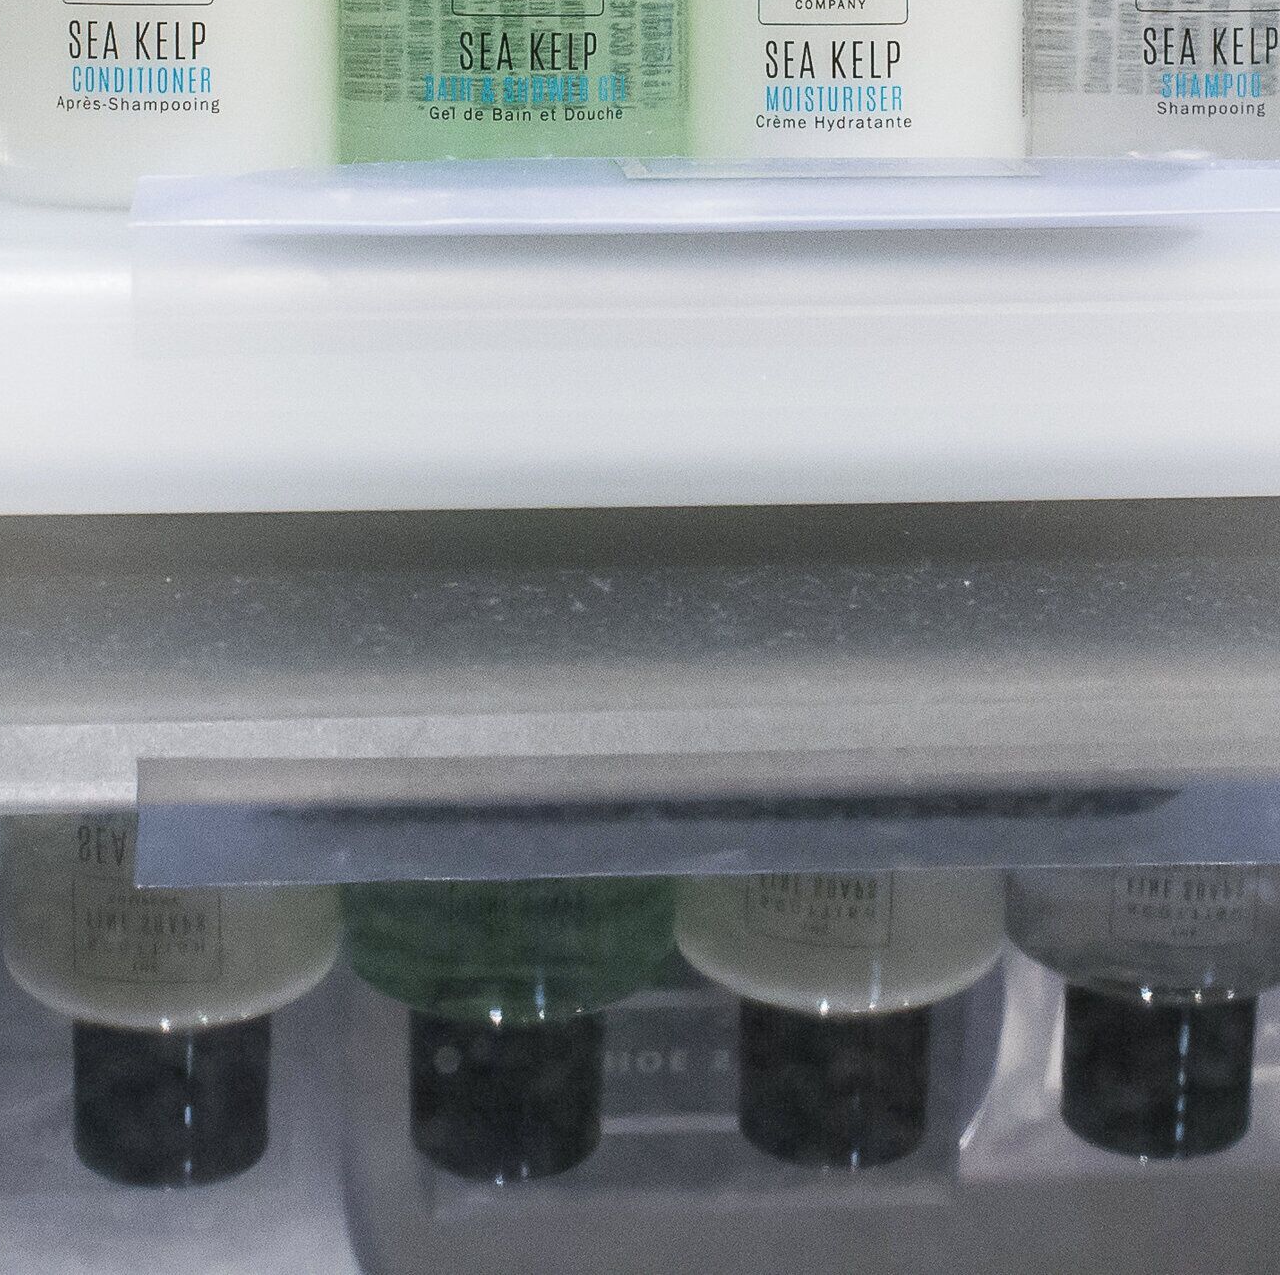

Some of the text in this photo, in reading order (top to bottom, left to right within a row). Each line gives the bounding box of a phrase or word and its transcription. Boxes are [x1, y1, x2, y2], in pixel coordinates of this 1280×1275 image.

[795, 0, 867, 11] COMPANY
[68, 19, 207, 61] SEA KELP
[459, 31, 597, 72] SEA KELP
[1143, 26, 1278, 66] SEA KELP
[765, 40, 902, 79] SEA KELP
[71, 65, 212, 94] CONDITIONER
[1160, 72, 1262, 99] SHAMPOO
[56, 95, 221, 114] Après-Shampooing
[766, 85, 903, 112] MOISTURISER
[1156, 101, 1266, 117] Shampooing
[429, 105, 624, 122] Gel de Bain et Douche
[755, 113, 913, 132] Crème Hydratante
